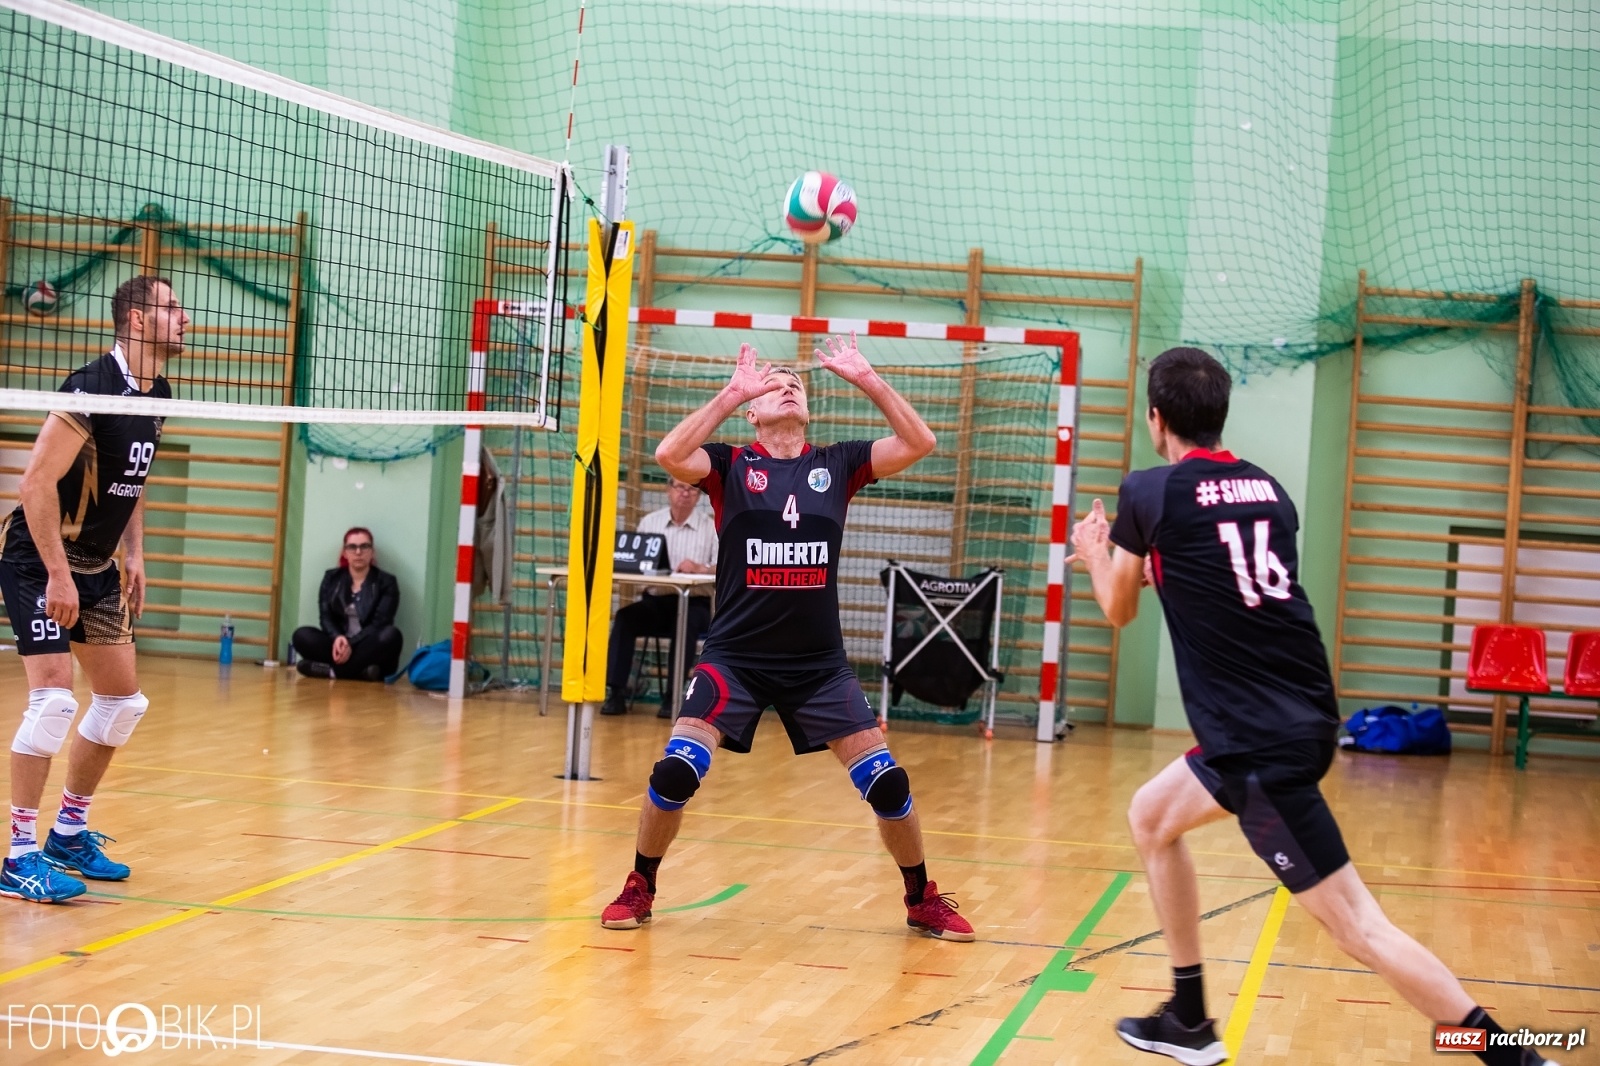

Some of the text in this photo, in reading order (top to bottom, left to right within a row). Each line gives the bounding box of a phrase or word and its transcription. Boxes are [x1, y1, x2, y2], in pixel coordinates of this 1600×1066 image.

[123, 441, 155, 477] 99
[782, 494, 800, 529] 4
[644, 536, 662, 558] 19
[746, 538, 829, 565] OMERTA
[746, 567, 827, 586] NORTHERN
[1217, 520, 1292, 608] 16
[31, 618, 61, 641] 99
